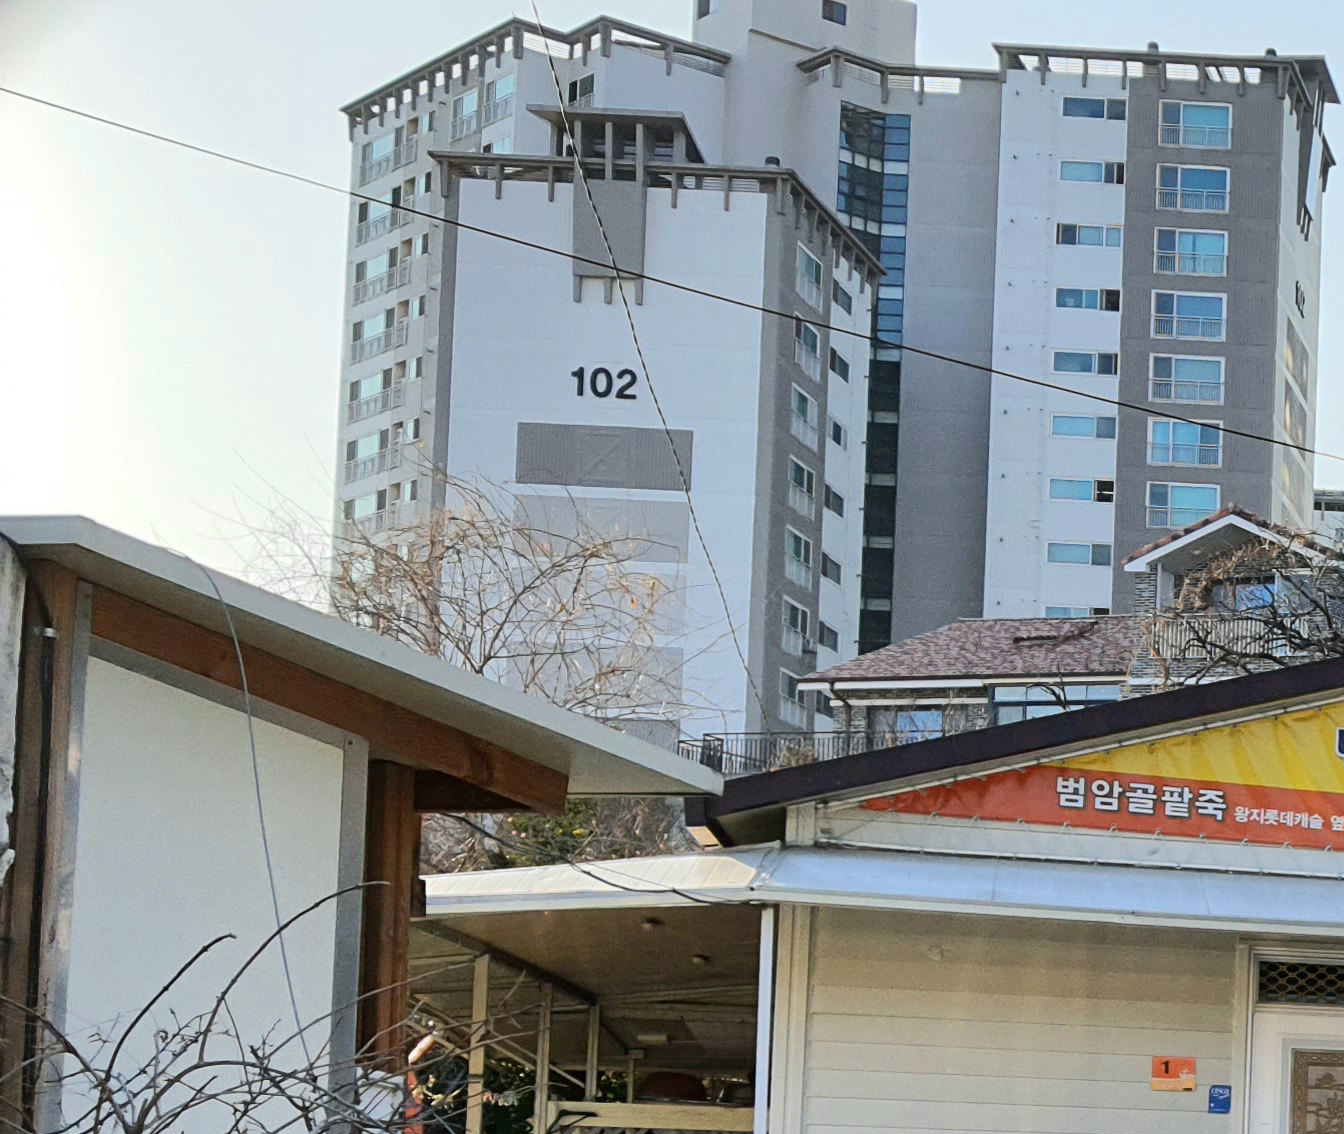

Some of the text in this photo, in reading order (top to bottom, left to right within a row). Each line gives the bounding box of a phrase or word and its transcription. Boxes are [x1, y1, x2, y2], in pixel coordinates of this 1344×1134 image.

[571, 366, 637, 400] 102
[1055, 776, 1227, 820] 범암골팥죽
[1234, 806, 1344, 831] 왕지롯데캐슬 옆
[1161, 1060, 1170, 1075] 1
